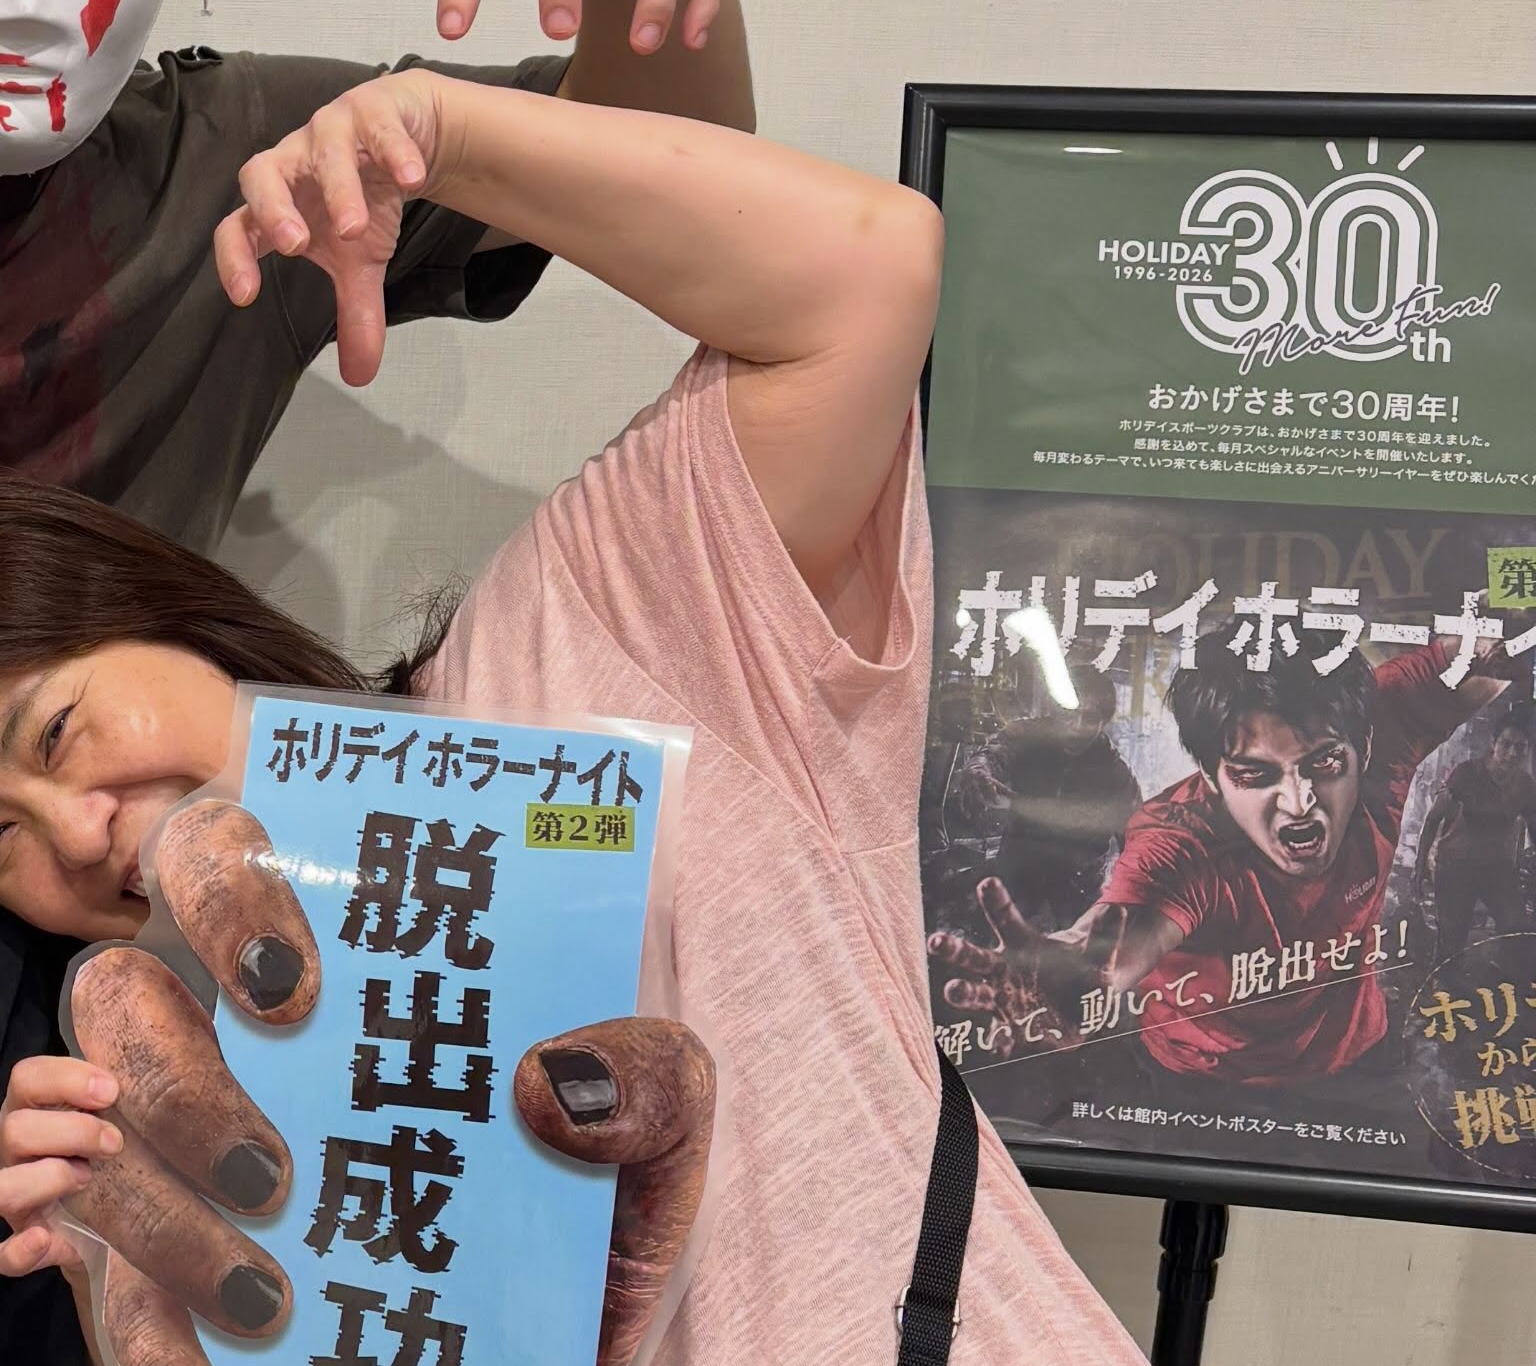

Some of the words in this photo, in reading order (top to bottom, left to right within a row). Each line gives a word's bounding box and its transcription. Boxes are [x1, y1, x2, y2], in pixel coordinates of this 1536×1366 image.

[1098, 239, 1231, 266] HOLIDAY
[1176, 168, 1439, 363] 30
[1113, 265, 1214, 283] 1996-2026
[1232, 320, 1386, 375] More
[1394, 282, 1502, 340] Fun!
[1409, 327, 1453, 364] th
[1148, 383, 1461, 424] おかげさまで30周年!
[1119, 419, 1492, 448] ホリデイスポーツクラブは、おかげさまで30周年を迎えました。
[1134, 438, 1474, 466] 感謝を込めて、毎月スペシャルなイベントを開催いたします。
[266, 717, 644, 806] ホリデイホラーナイト
[533, 810, 627, 845] 第2弾
[934, 919, 1410, 1066] 解いて、動いて、脱出せよ!
[1420, 982, 1536, 1042] ホリ
[1072, 1101, 1407, 1147] 詳しくは館内イベントポスターをご覧ください
